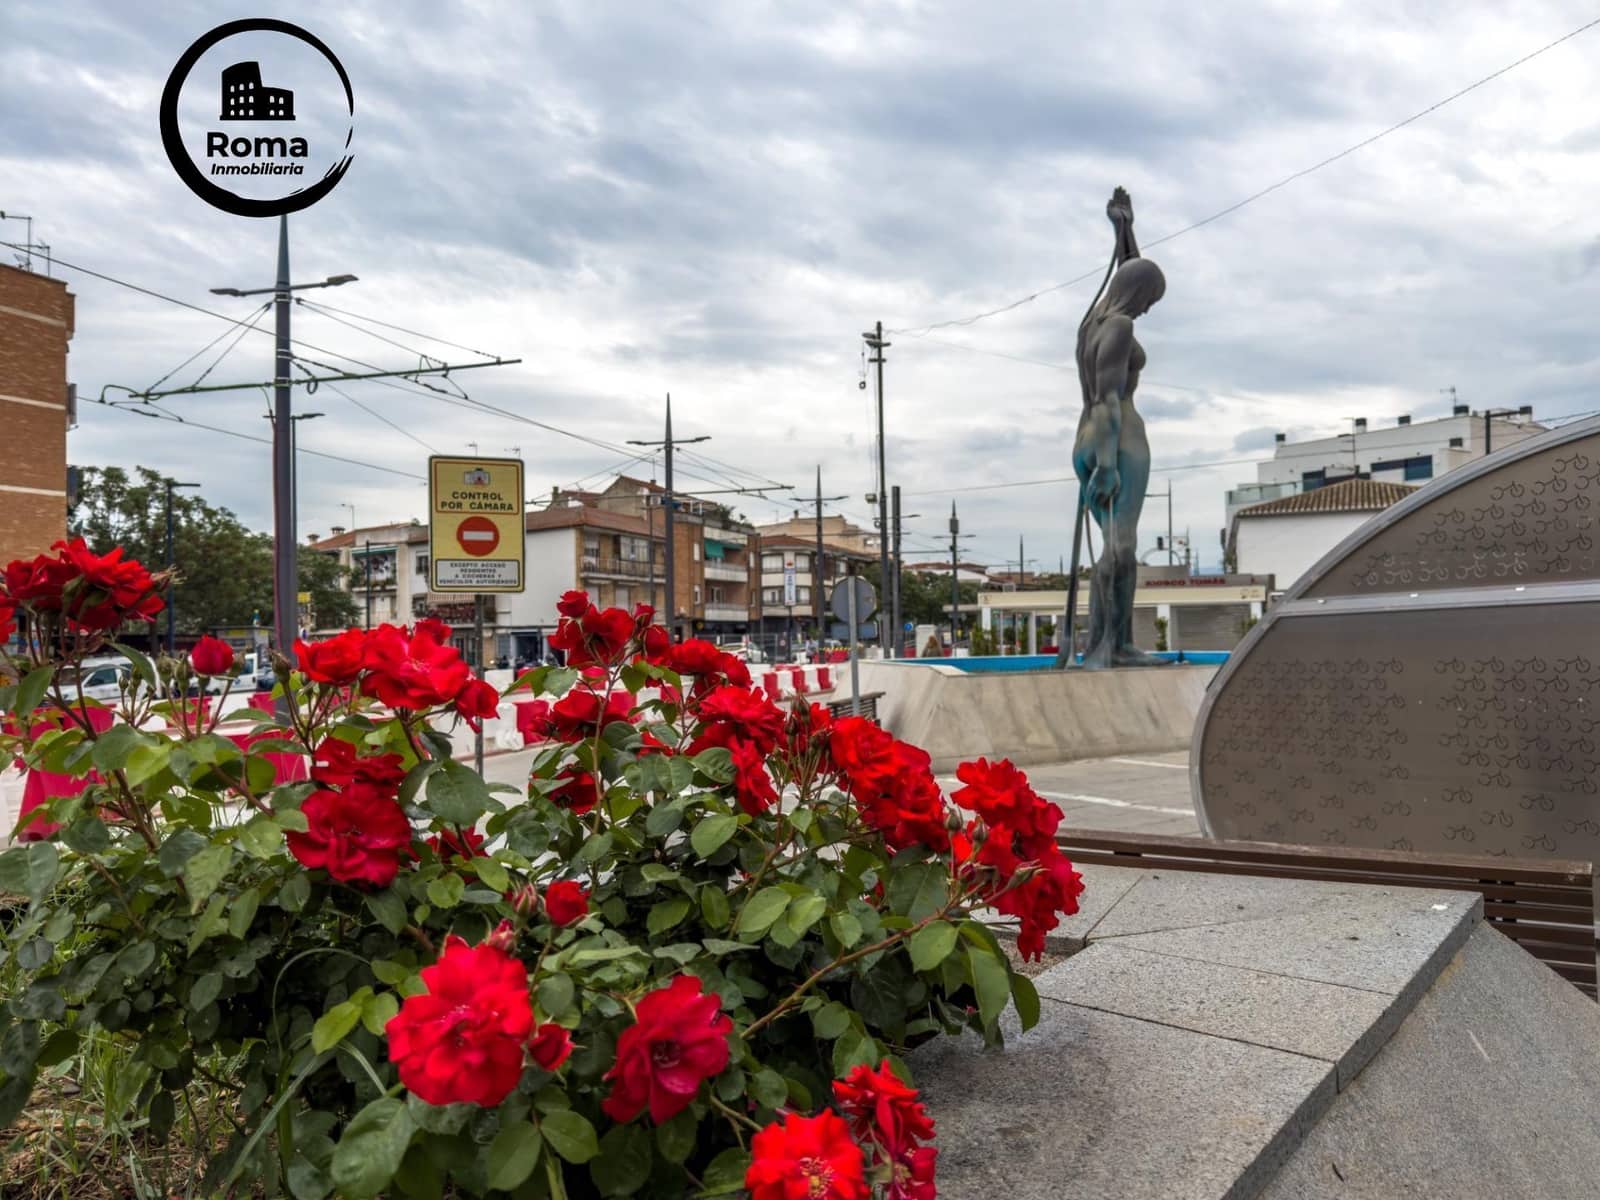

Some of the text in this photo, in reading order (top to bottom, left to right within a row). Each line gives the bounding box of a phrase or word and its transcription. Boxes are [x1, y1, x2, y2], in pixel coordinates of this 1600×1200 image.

[452, 491, 504, 501] CONTROL
[441, 501, 514, 511] POR CÁMARA
